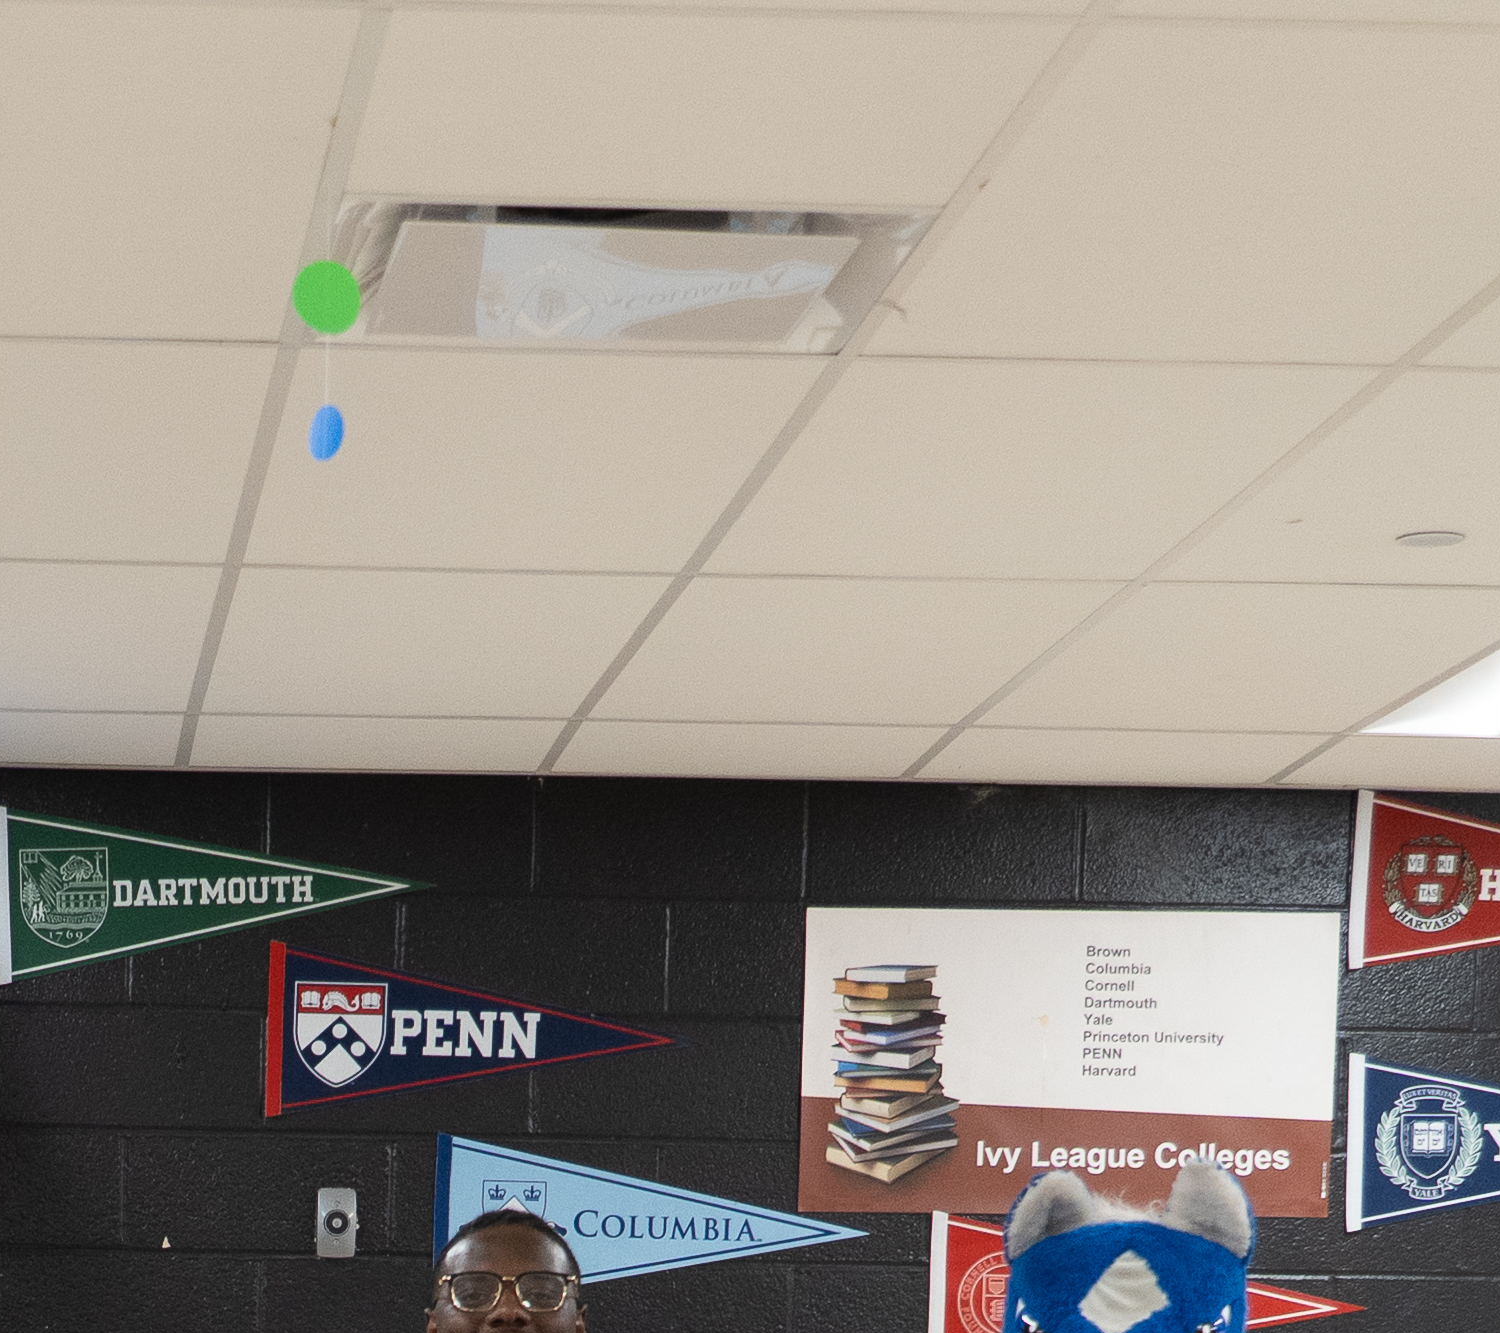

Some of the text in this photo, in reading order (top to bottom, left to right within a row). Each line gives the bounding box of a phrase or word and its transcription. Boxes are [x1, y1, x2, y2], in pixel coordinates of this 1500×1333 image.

[113, 875, 315, 907] DARTMOUTH
[1397, 910, 1460, 930] HARVARD
[48, 930, 84, 942] 1769
[1086, 945, 1131, 957] Brown
[1085, 962, 1151, 975] Columbia
[1085, 979, 1135, 991] Cornell
[1084, 996, 1157, 1009] Dartmouth
[1083, 1013, 1113, 1025] Yale
[390, 1010, 541, 1059] PENN
[1083, 1031, 1224, 1046] Princeton University
[1083, 1048, 1122, 1059] PENN
[1082, 1065, 1137, 1077] Harvard
[976, 1140, 1291, 1176] Ivy League Colleges
[1414, 1188, 1440, 1198] YALE
[573, 1209, 757, 1243] COLUMBIA
